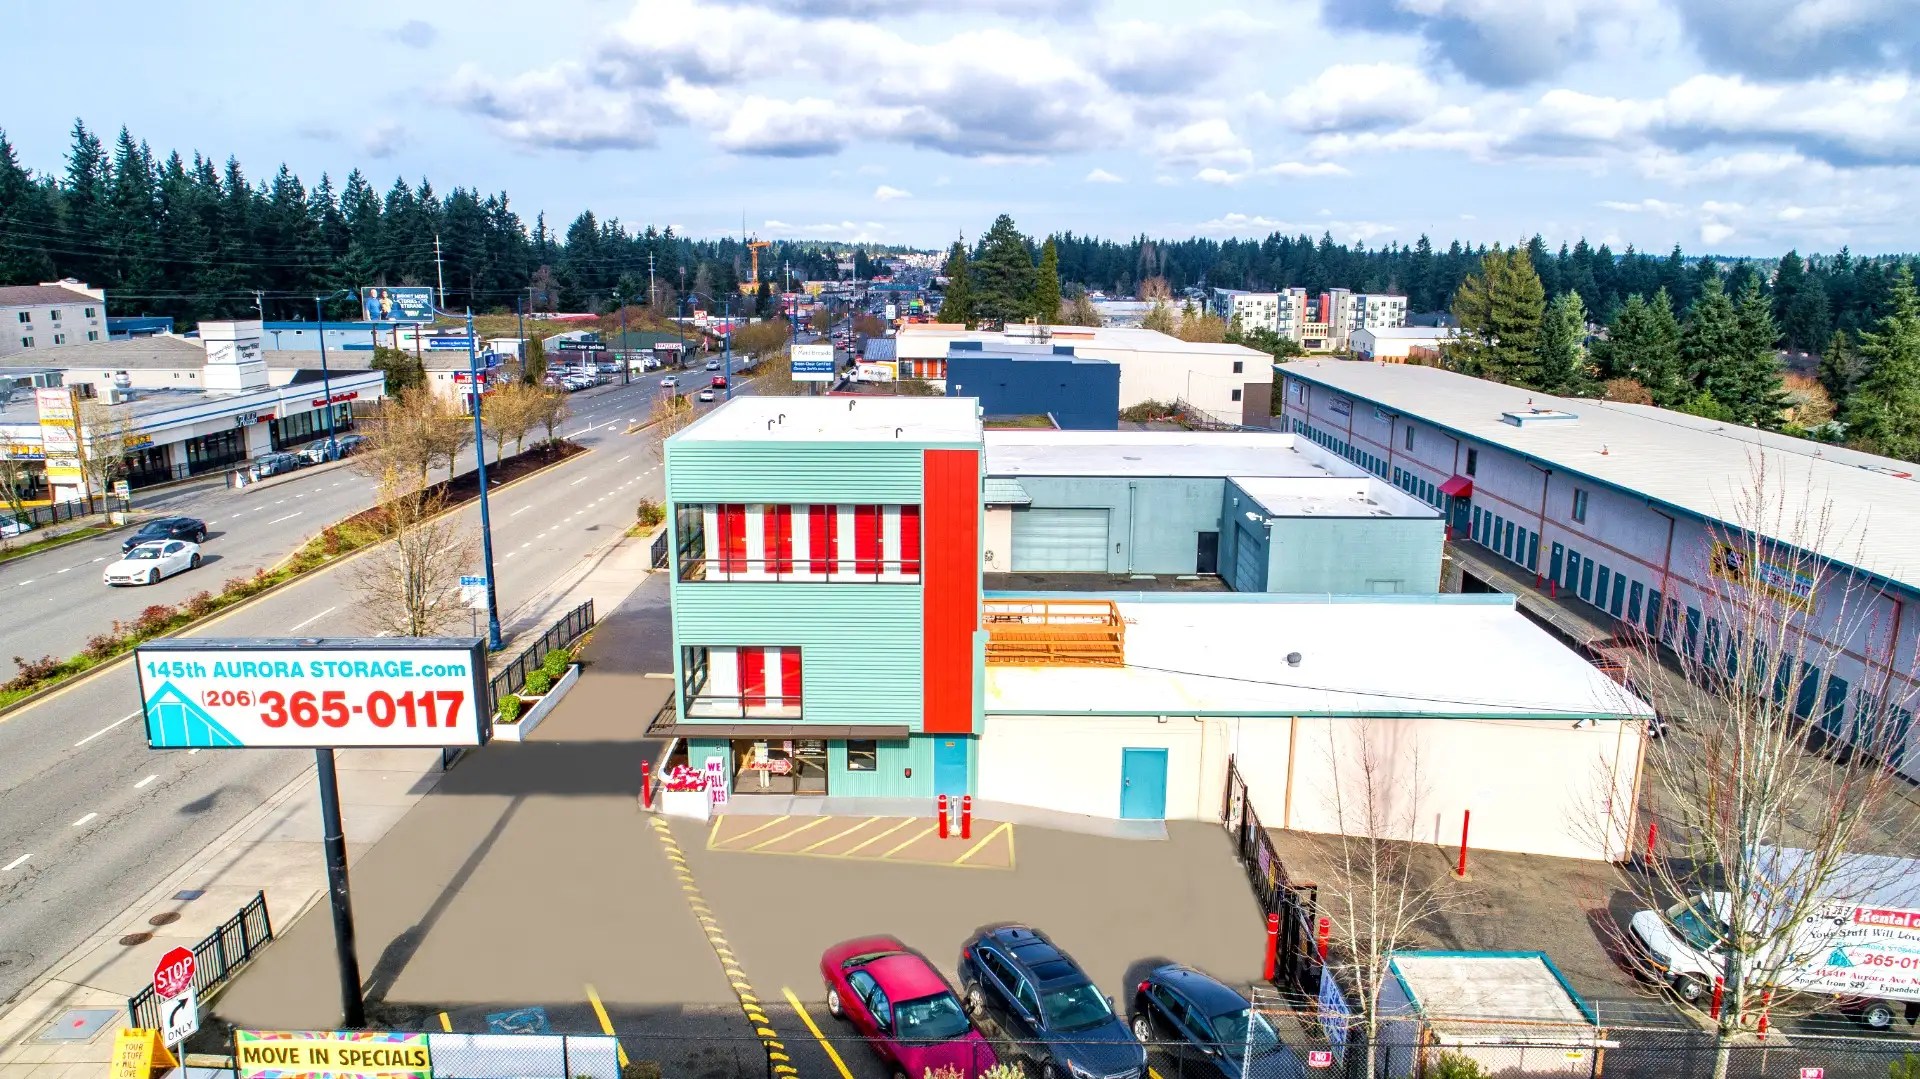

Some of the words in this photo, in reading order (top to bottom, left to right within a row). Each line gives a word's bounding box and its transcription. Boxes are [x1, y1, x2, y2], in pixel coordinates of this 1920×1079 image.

[147, 661, 207, 678] 145th
[213, 661, 305, 678] AURORA
[310, 660, 466, 678] STORAGE.com
[201, 690, 256, 707] (206)
[259, 690, 465, 728] 365-0117
[707, 762, 721, 772] WE
[1859, 909, 1910, 927] Rental
[1873, 928, 1894, 938] Will
[1863, 953, 1920, 969] 365-01
[157, 956, 193, 989] STOP
[1879, 983, 1920, 995] Expanded
[168, 1020, 193, 1041] ONLY
[122, 1051, 143, 1059] STUFF
[243, 1047, 300, 1064] MOVE
[309, 1048, 330, 1065] IN
[338, 1049, 426, 1067] SPECIALS
[1315, 1051, 1326, 1062] NO
[120, 1069, 137, 1078] LOVE
